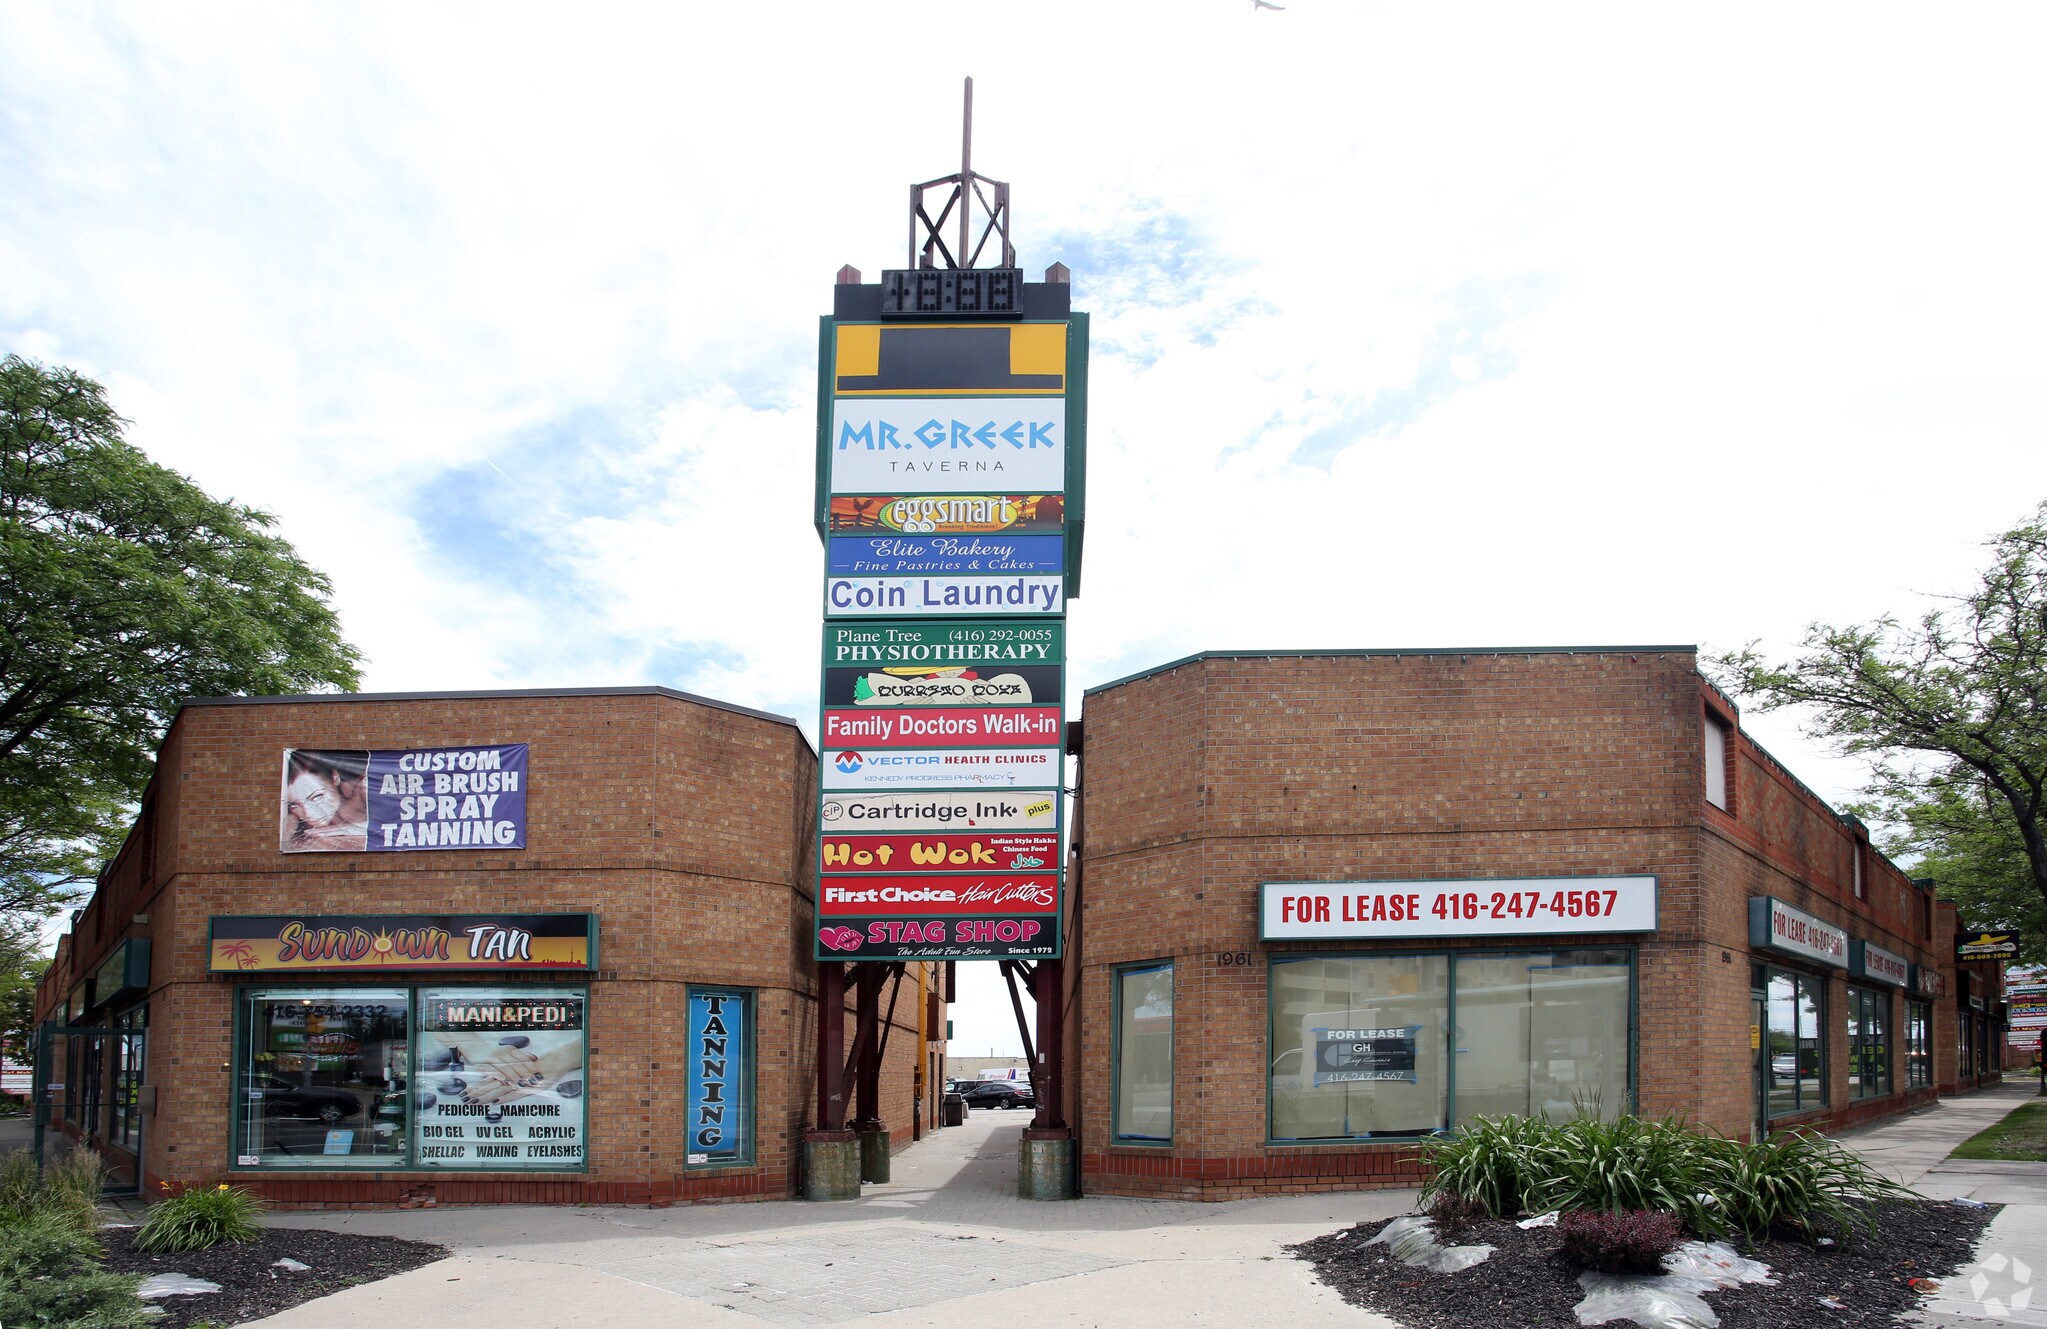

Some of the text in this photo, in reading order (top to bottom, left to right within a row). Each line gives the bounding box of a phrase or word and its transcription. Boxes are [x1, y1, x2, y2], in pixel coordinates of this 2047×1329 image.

[890, 461, 1004, 472] TAVERNA
[893, 496, 1012, 533] eggsmart
[870, 539, 1016, 561] Elite Bakery
[853, 560, 1035, 571] Fine Pastries & Cakes
[831, 578, 1059, 611] Coin Laundry
[836, 629, 1052, 643] Plane Tree (416) 292-0055
[835, 644, 1051, 661] PHYSIOTHERAPY
[827, 713, 1057, 740] Family Doctors Walk-in
[399, 750, 500, 772] CUSTOM
[867, 755, 1047, 766] VECTOR HEALTH CLINICS
[380, 772, 518, 795] AIR BRUSH
[905, 774, 953, 782] PROGRESS
[954, 774, 1006, 782] PHARMACY
[400, 795, 499, 821] SPRAY
[848, 802, 1051, 821] Cartridge Ink plus
[381, 821, 516, 847] TANNING
[823, 842, 997, 866] Hot Wok
[1011, 853, 1045, 869] حلال
[1282, 890, 1618, 923] FOR LEASE 416-247-4567
[868, 920, 1041, 944] STAG SHOP
[1774, 911, 1786, 937] FOR
[1788, 917, 1806, 944] LEASE
[897, 947, 912, 956] The
[914, 947, 943, 955] Adult
[944, 947, 960, 956] Fun
[962, 947, 991, 956] Store
[1216, 953, 1252, 966] 1961
[1327, 1029, 1405, 1040] FOR LEASE
[1353, 1043, 1371, 1053] GH
[697, 992, 729, 1147] TANNING
[1326, 1072, 1404, 1082] 416-247-4567
[438, 1104, 560, 1117] PEDICURE MANICURE
[423, 1126, 576, 1138] BIO GEL UV GEL ACRYLIC
[422, 1144, 582, 1158] SHELLAC WAXING EYELASHES
